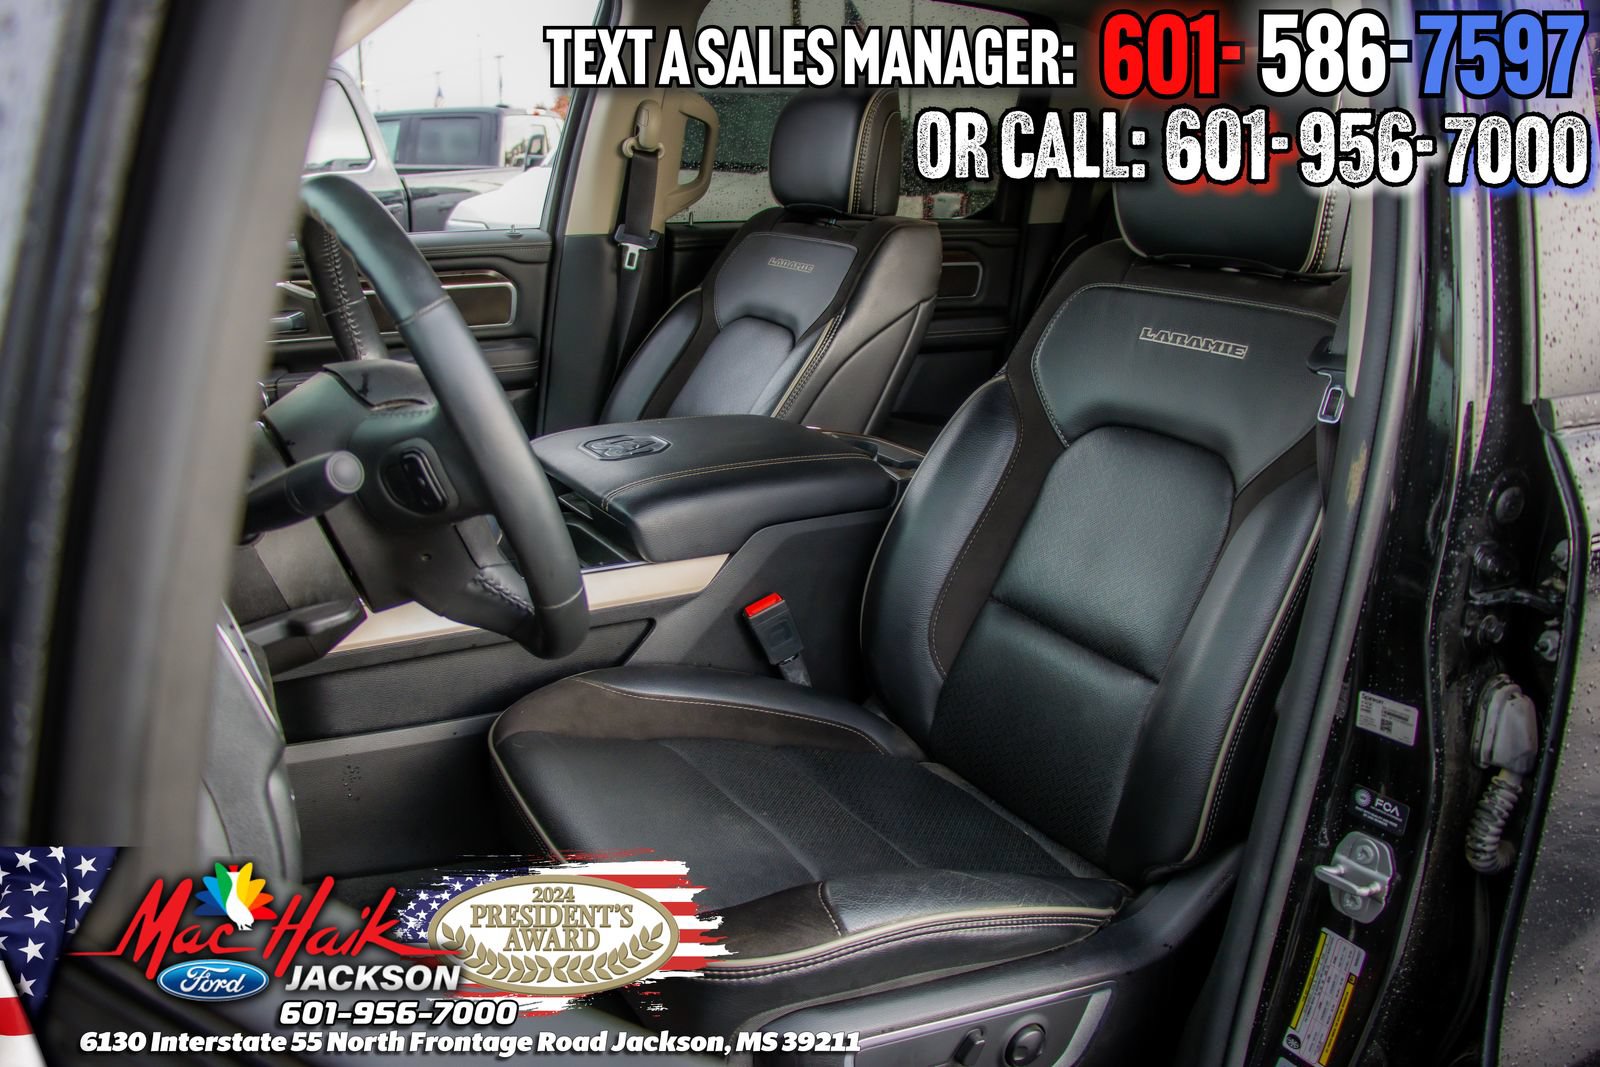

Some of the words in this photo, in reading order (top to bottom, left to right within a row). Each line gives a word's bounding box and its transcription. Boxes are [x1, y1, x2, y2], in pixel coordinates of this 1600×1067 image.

[767, 256, 815, 273] LARAMIE
[1139, 326, 1248, 359] LARAMIE
[1374, 798, 1401, 817] FCA
